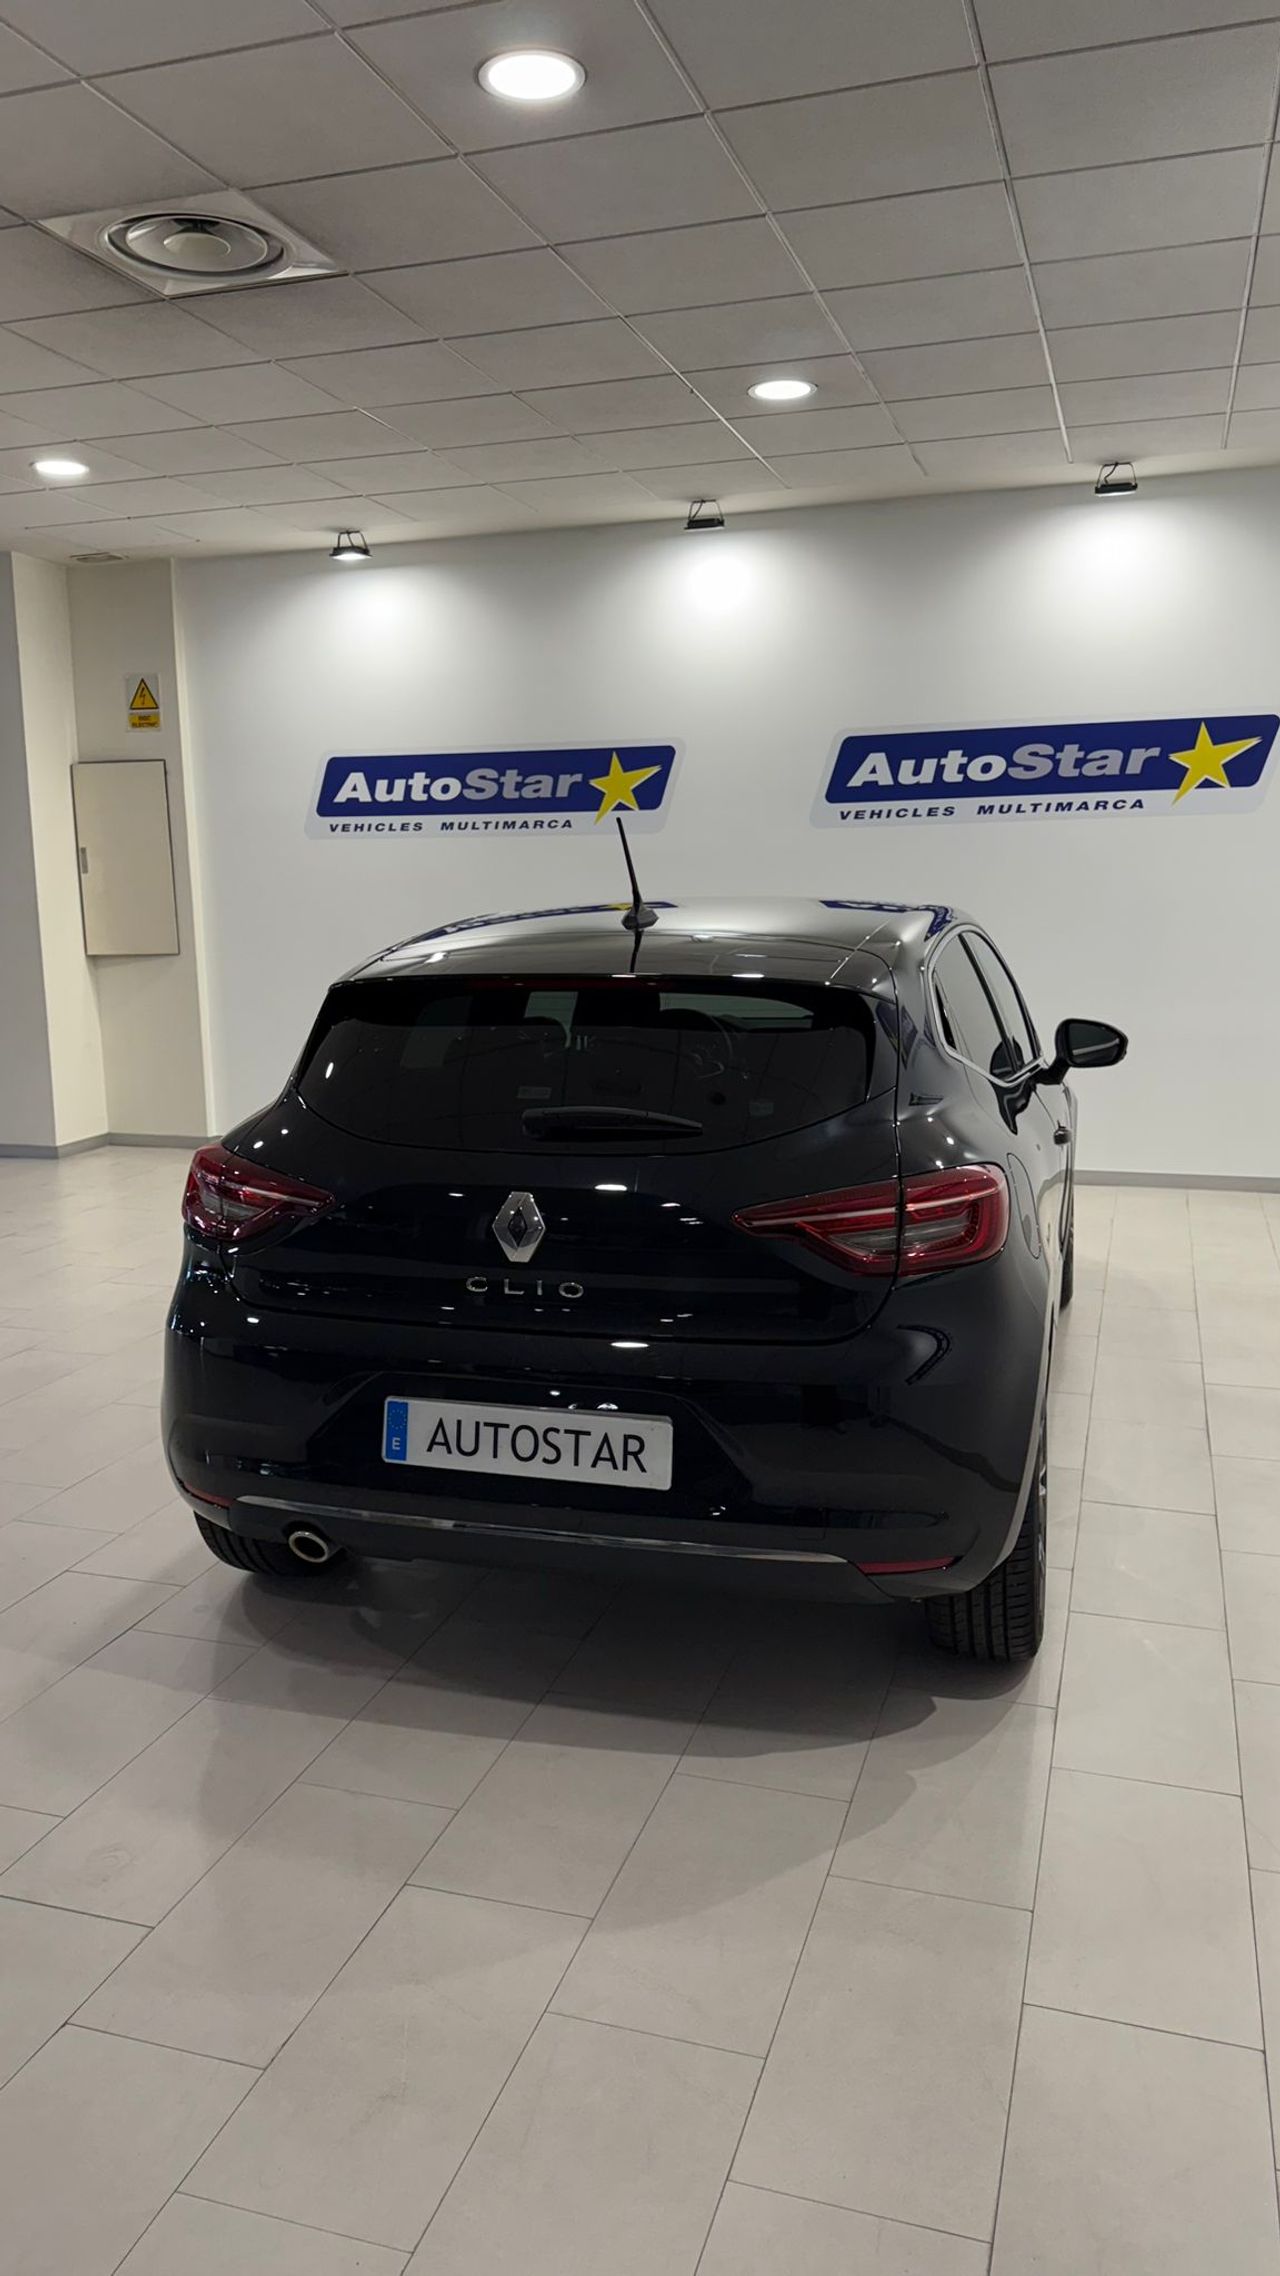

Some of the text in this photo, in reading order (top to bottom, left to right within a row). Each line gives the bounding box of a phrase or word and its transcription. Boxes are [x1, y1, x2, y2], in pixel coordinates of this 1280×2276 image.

[847, 743, 1160, 787] AutoStar
[334, 768, 583, 803] AutoStar
[839, 798, 1145, 821] VEHICLES MULTIMARCA
[329, 819, 573, 833] VEHICLES MULTIMARCA
[466, 1276, 584, 1298] CLIO
[392, 1417, 648, 1473] E AUTOSTAR
